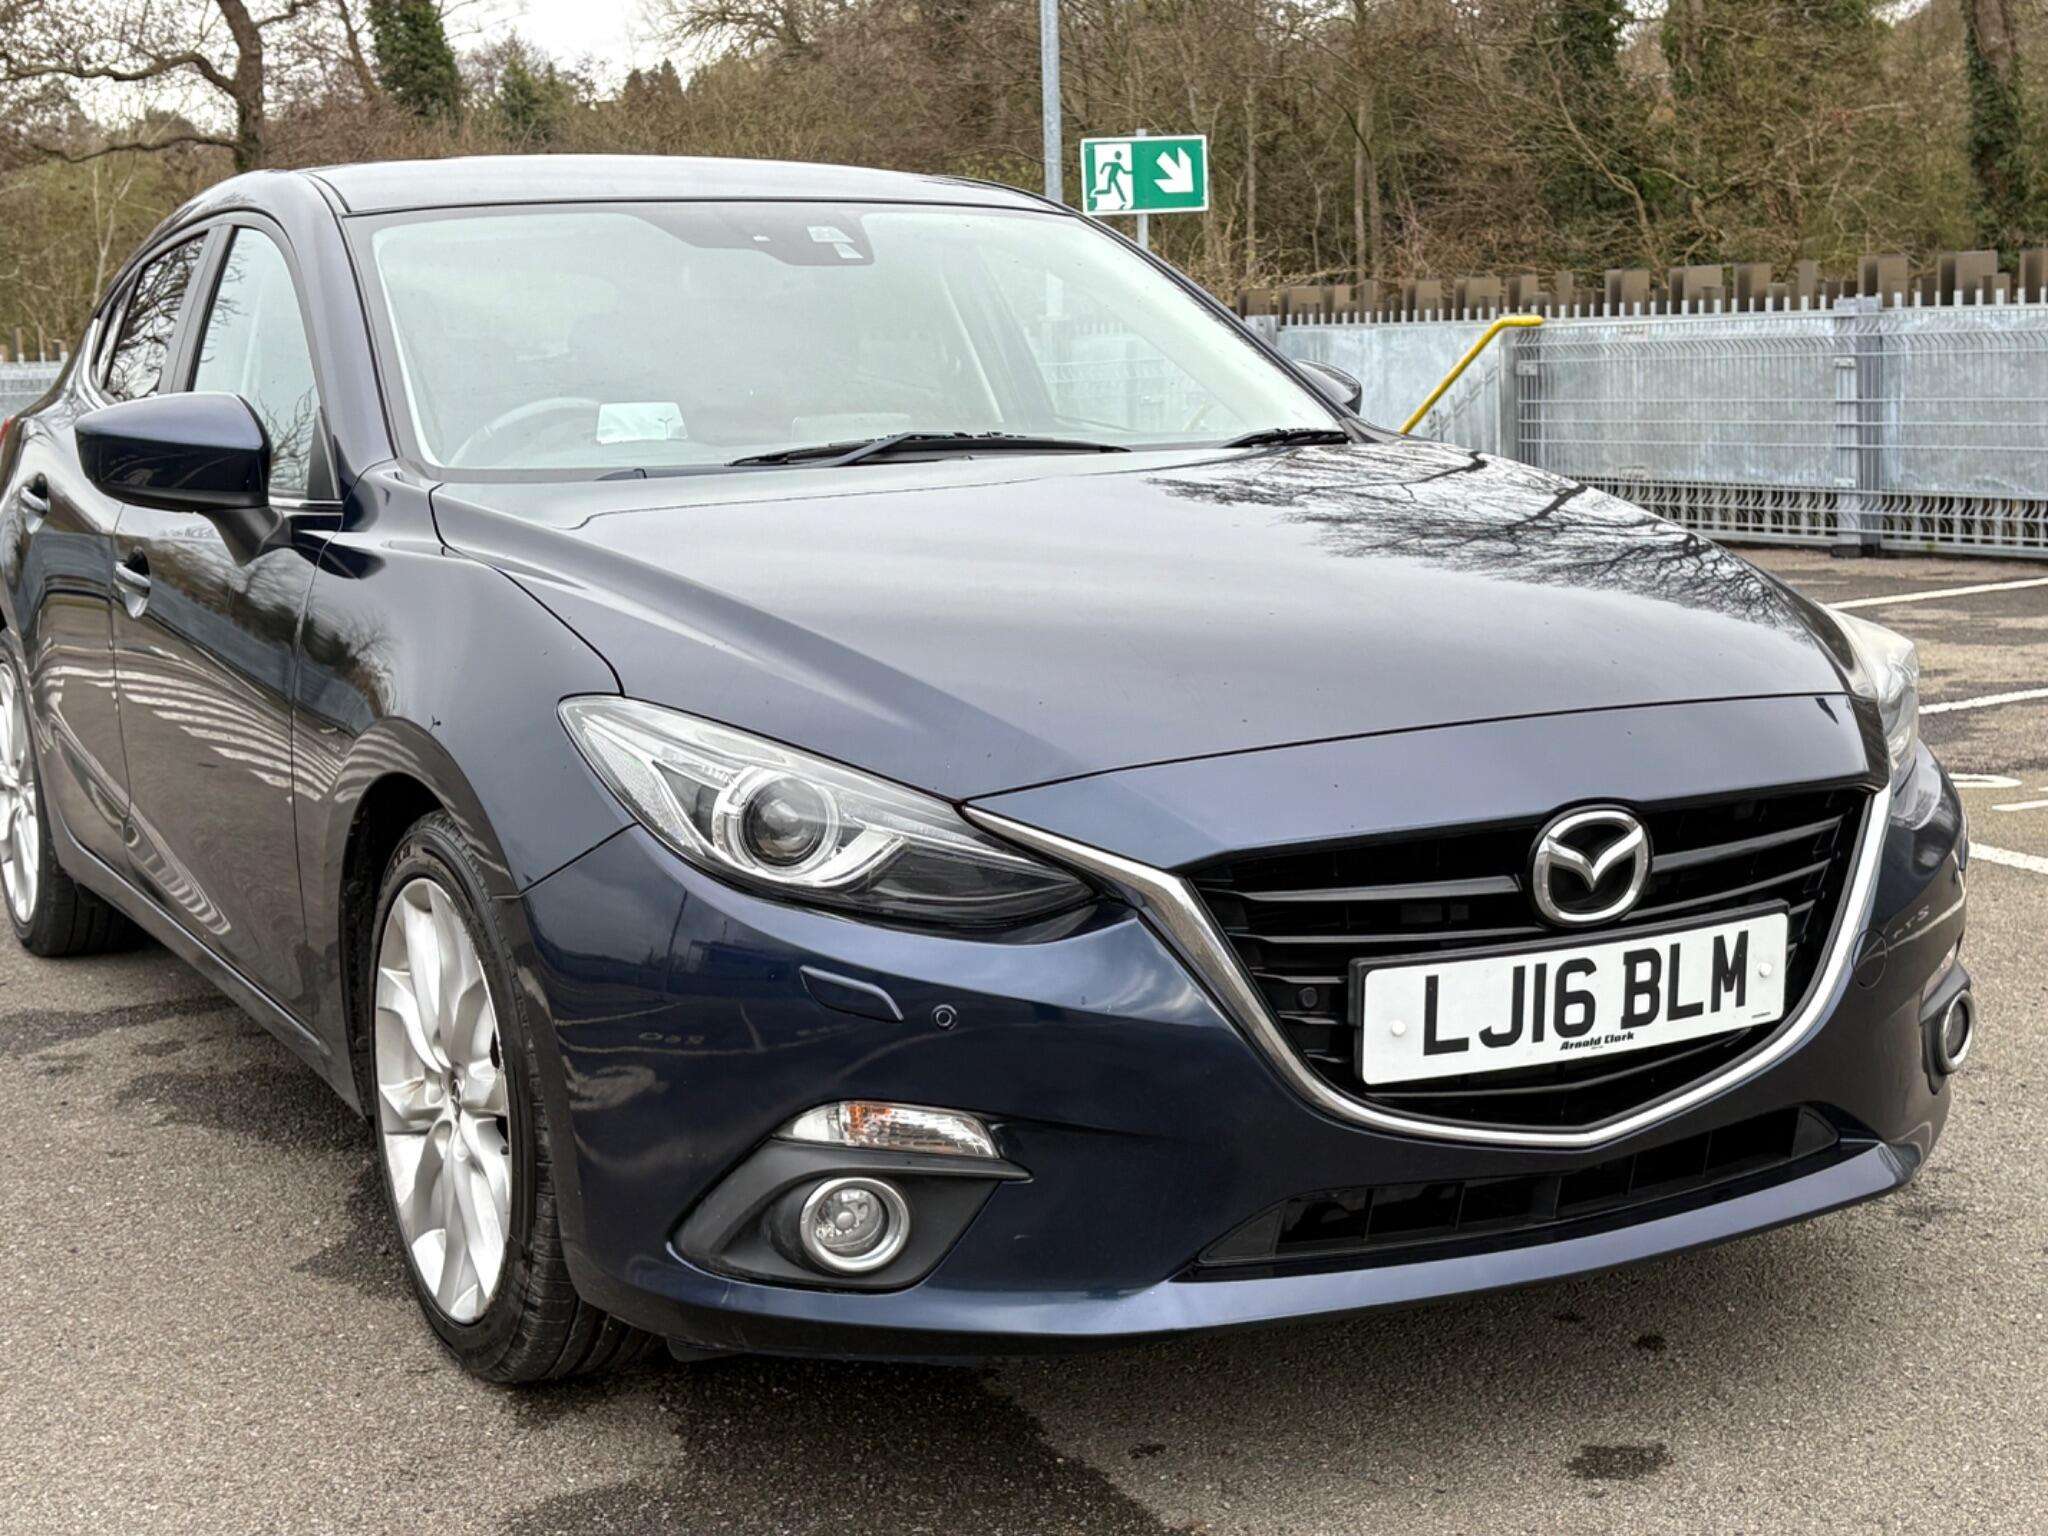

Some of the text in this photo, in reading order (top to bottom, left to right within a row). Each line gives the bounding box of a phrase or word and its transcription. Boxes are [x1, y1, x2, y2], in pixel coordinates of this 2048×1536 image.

[1423, 930, 1749, 1056] LJ16 BLM
[1560, 1036, 1602, 1051] Arnold
[1604, 1031, 1634, 1044] Clark
